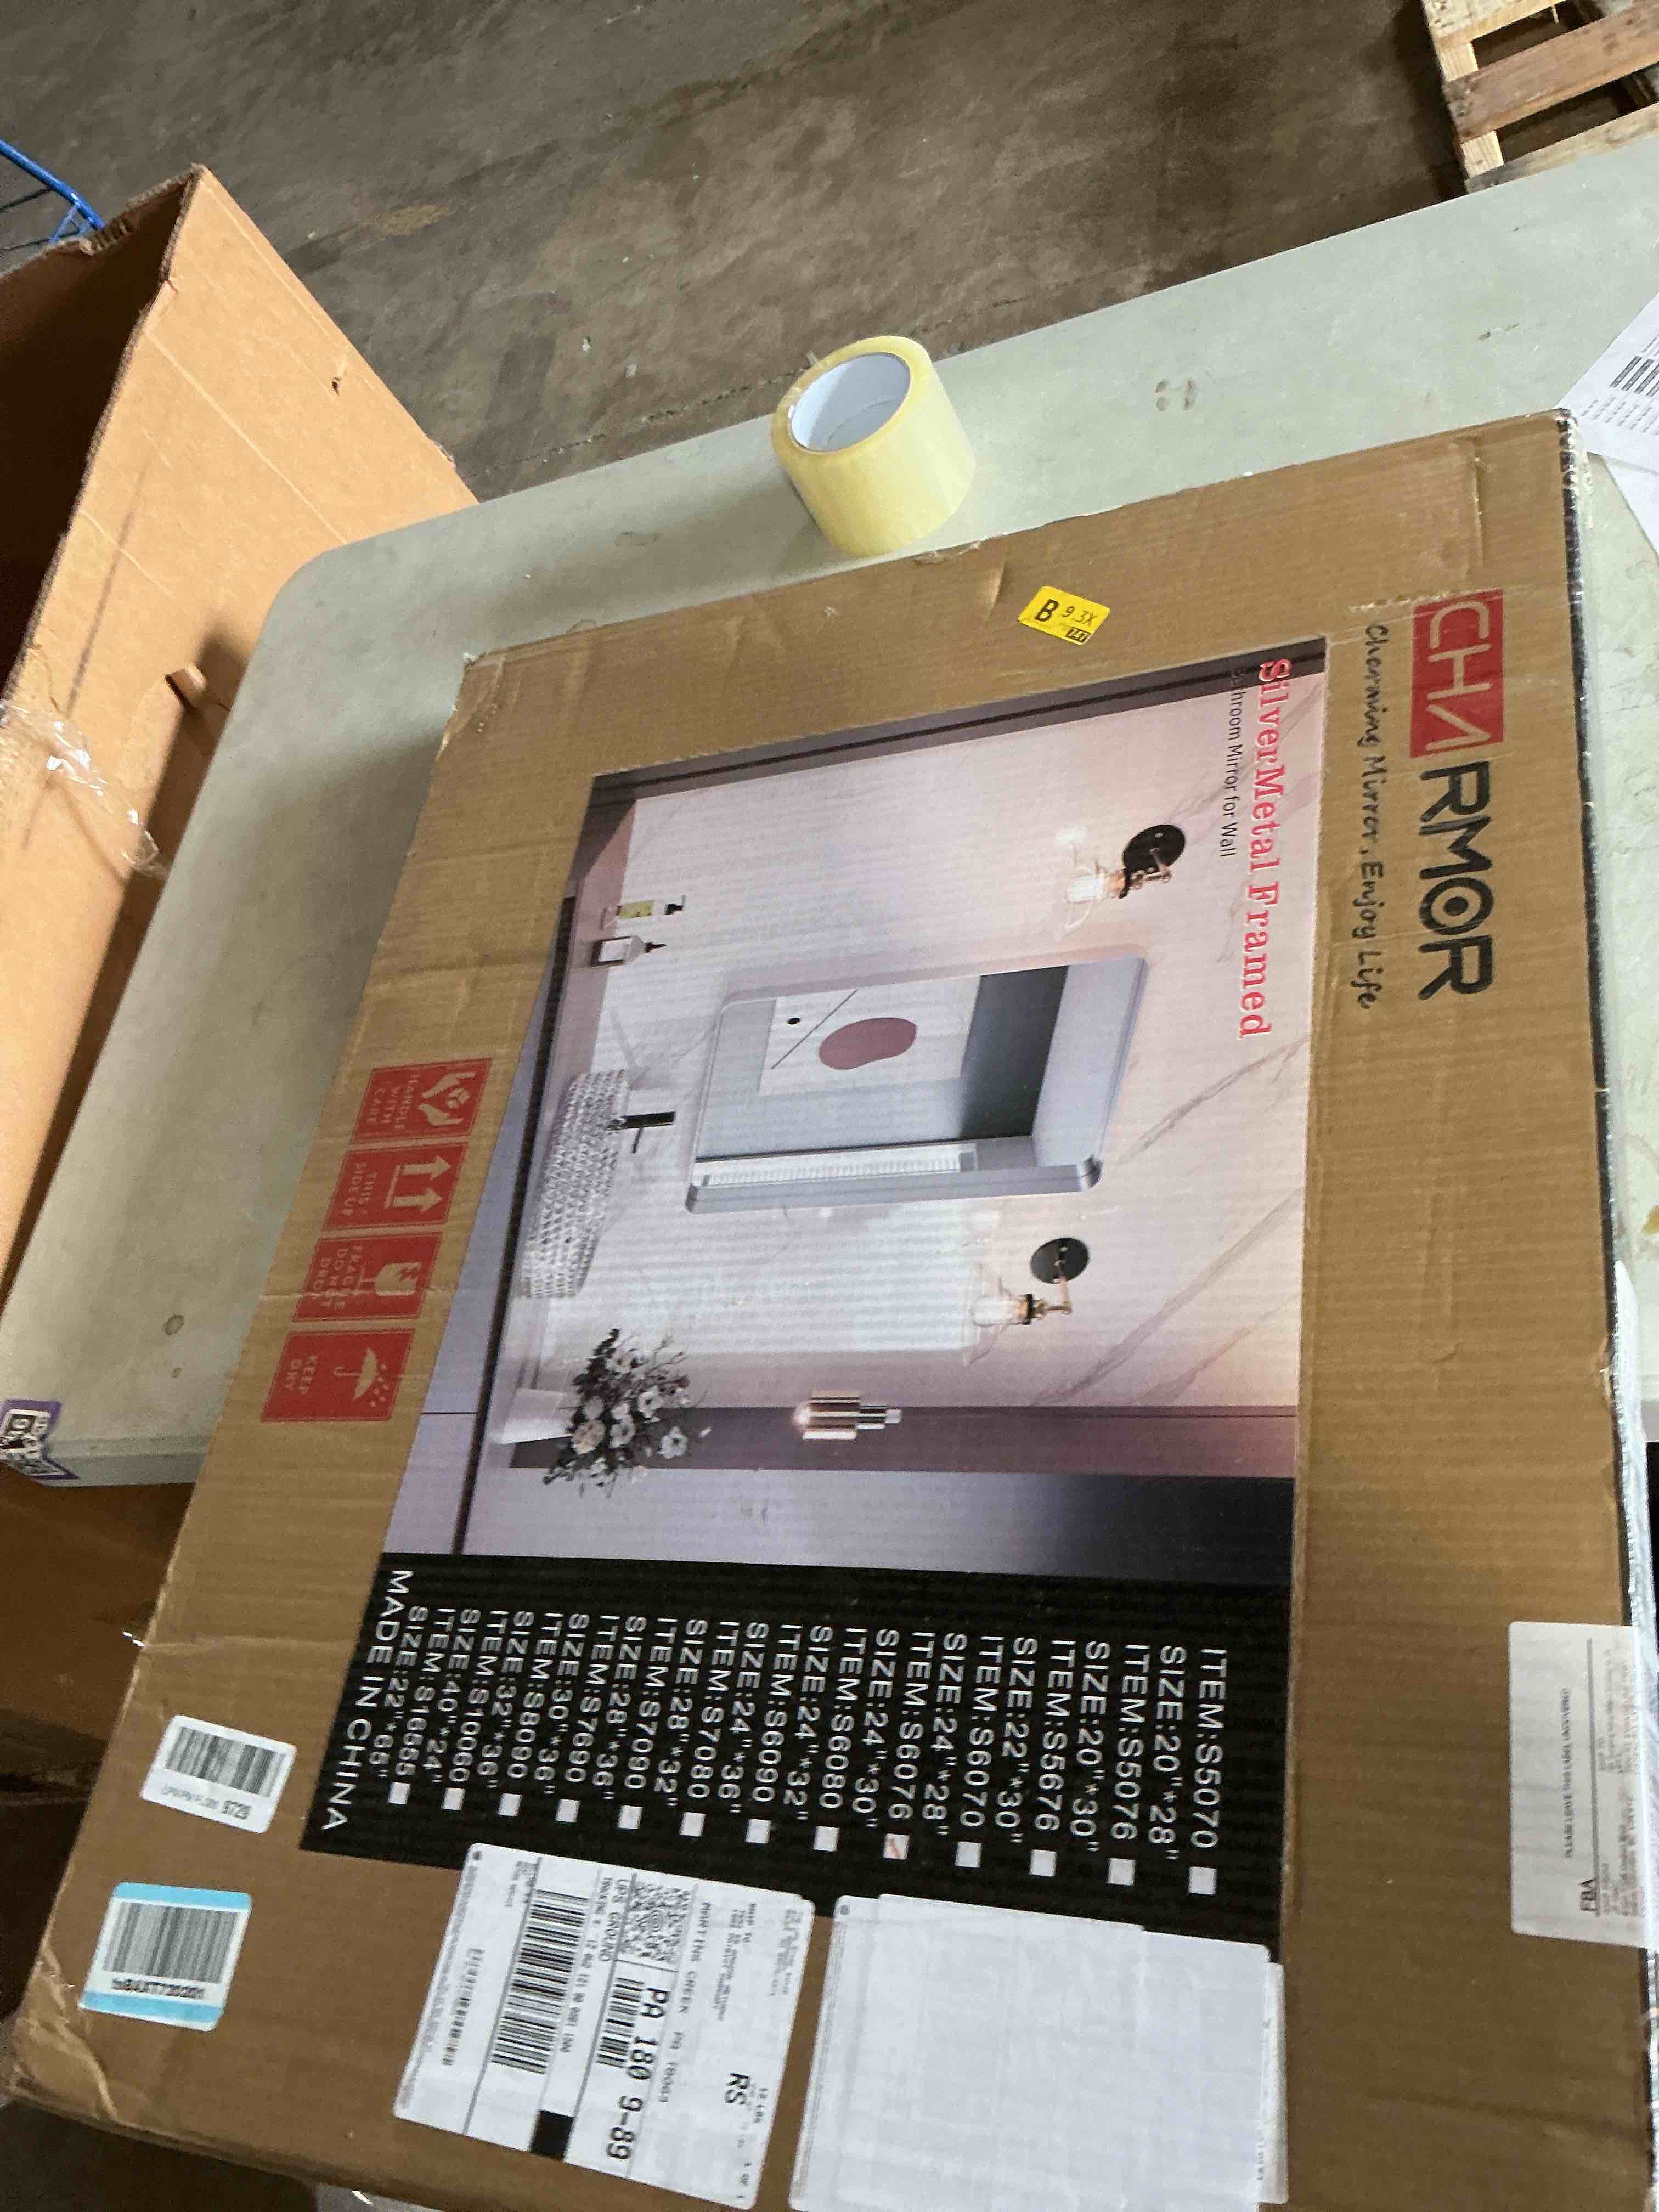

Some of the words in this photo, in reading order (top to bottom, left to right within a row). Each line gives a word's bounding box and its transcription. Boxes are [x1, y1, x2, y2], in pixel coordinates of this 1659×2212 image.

[1035, 599, 1059, 622] B
[1357, 624, 1389, 747] Charming
[1223, 744, 1243, 791] Mirror
[1222, 795, 1240, 818] for
[1220, 822, 1238, 857] Wall
[1237, 882, 1280, 1041] Framed
[1350, 951, 1384, 1011] Life
[366, 1088, 386, 1124] CARE
[381, 1086, 402, 1124] WITH
[394, 1074, 419, 1131] HANDLE
[348, 1163, 368, 1194] SIDE
[358, 1171, 378, 1206] THIS
[342, 1198, 357, 1217] UP
[285, 1359, 302, 1390] DRY
[298, 1355, 319, 1395] KEEP
[365, 1570, 414, 1664] MADE
[354, 1675, 386, 1707] IN
[624, 1618, 679, 1790] ITEM:S7090
[686, 1621, 740, 1799] ITEM:S7080
[752, 1623, 803, 1802] ITEM:S6090
[819, 1627, 868, 1809] ITEM:S6080
[888, 1631, 935, 1819] ITEM:S6076
[959, 1635, 1005, 1827] ITEM:S6070
[1034, 1639, 1076, 1832] ITEM:S5676
[1110, 1644, 1150, 1840] ITEM:S5076
[1189, 1649, 1227, 1849] ITEM:S5070
[320, 1718, 373, 1831] CHINA
[608, 1878, 629, 1905] UPS
[1579, 1878, 1597, 1911] FBA
[597, 1911, 622, 1962] GROUND
[687, 1901, 712, 1962] MARTINS
[641, 1988, 671, 2019] PA
[678, 1970, 700, 2015] CREEK
[627, 2035, 658, 2080] 180
[671, 2032, 684, 2050] PA
[724, 2072, 751, 2106] RS
[605, 2095, 644, 2161] 9-89
